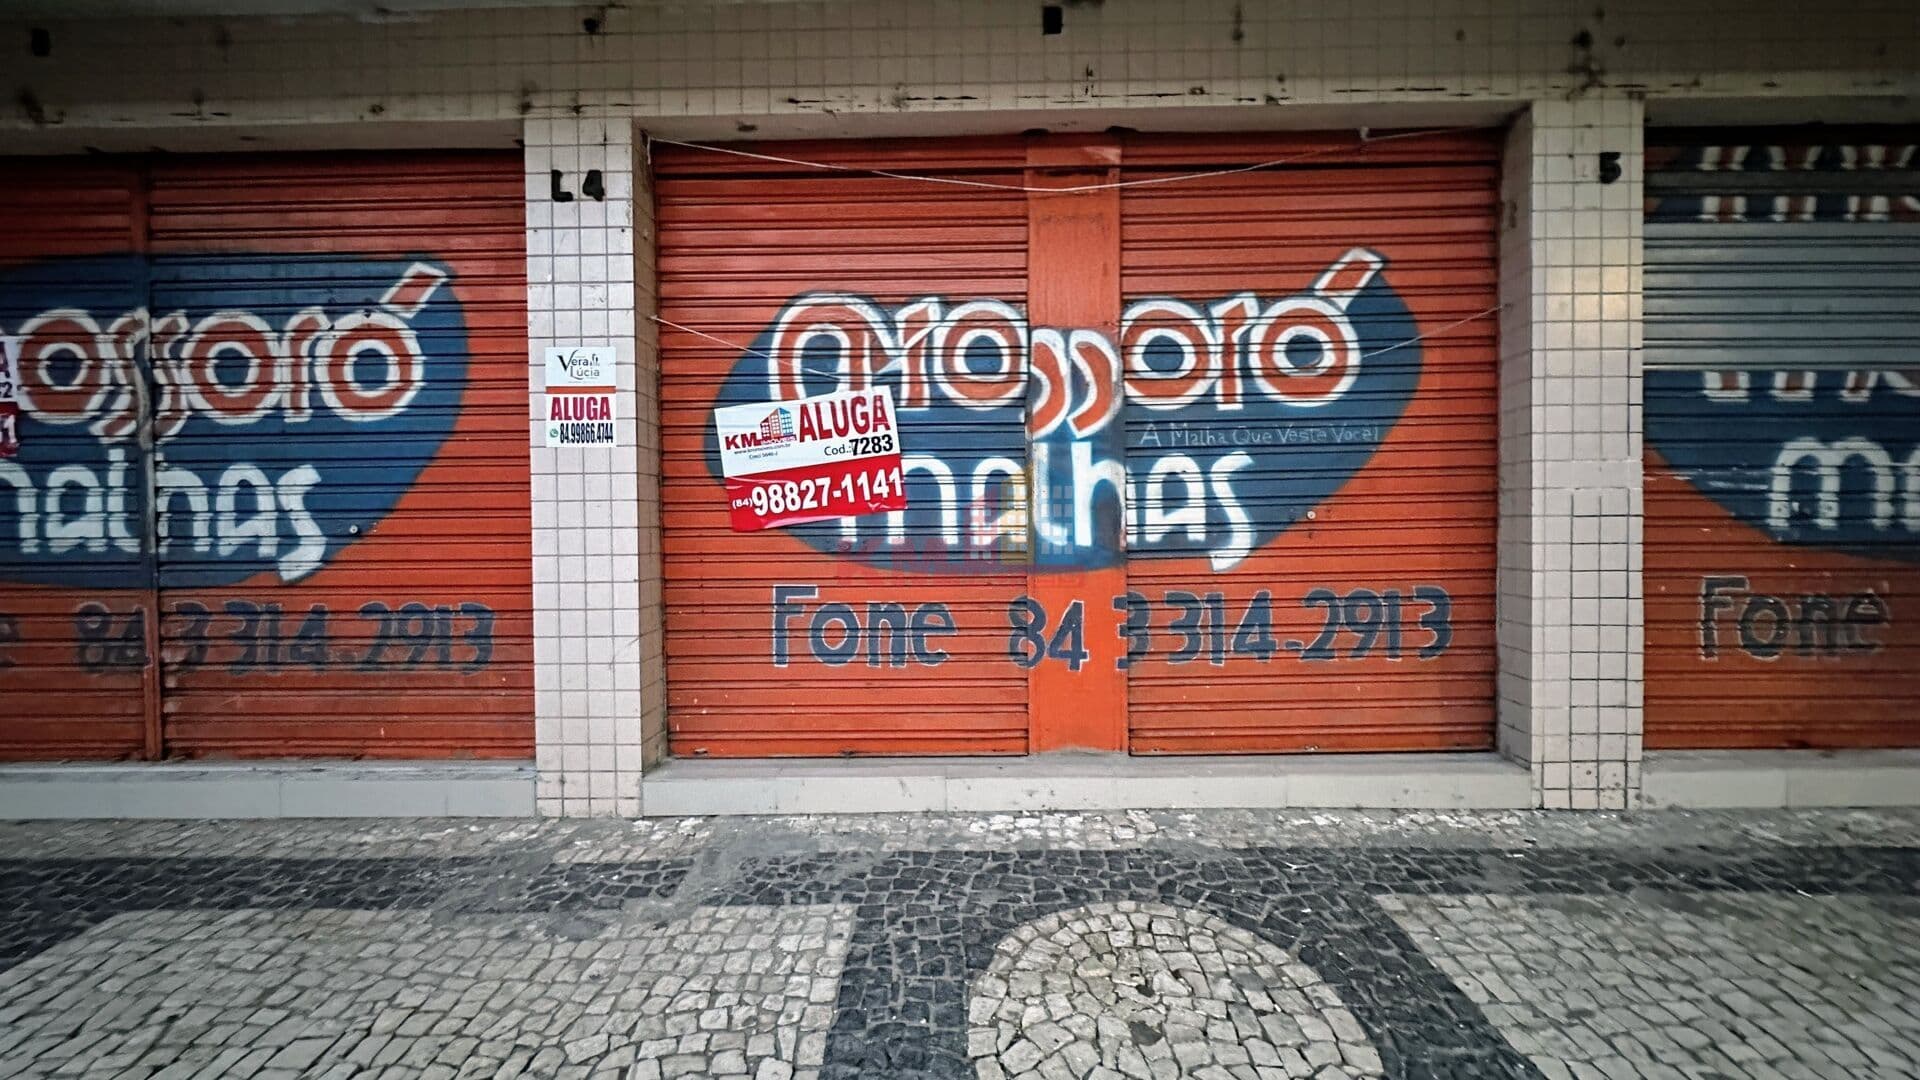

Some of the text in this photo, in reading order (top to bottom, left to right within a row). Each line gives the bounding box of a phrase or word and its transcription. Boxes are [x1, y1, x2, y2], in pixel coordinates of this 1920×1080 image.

[2, 262, 449, 443] ossoró
[557, 349, 589, 372] Vera
[570, 366, 600, 380] Lúcia
[550, 396, 612, 421] ALUGA
[799, 395, 891, 443] ALUGA
[849, 434, 893, 456] 7283
[1139, 423, 1161, 447] A
[1168, 422, 1226, 447] Malha
[1232, 425, 1272, 446] Que
[1275, 423, 1328, 444] Veste
[751, 467, 904, 517] 98827-1141
[771, 583, 958, 669] Fone
[1007, 594, 1090, 672] 84
[1697, 574, 1894, 663] Fone
